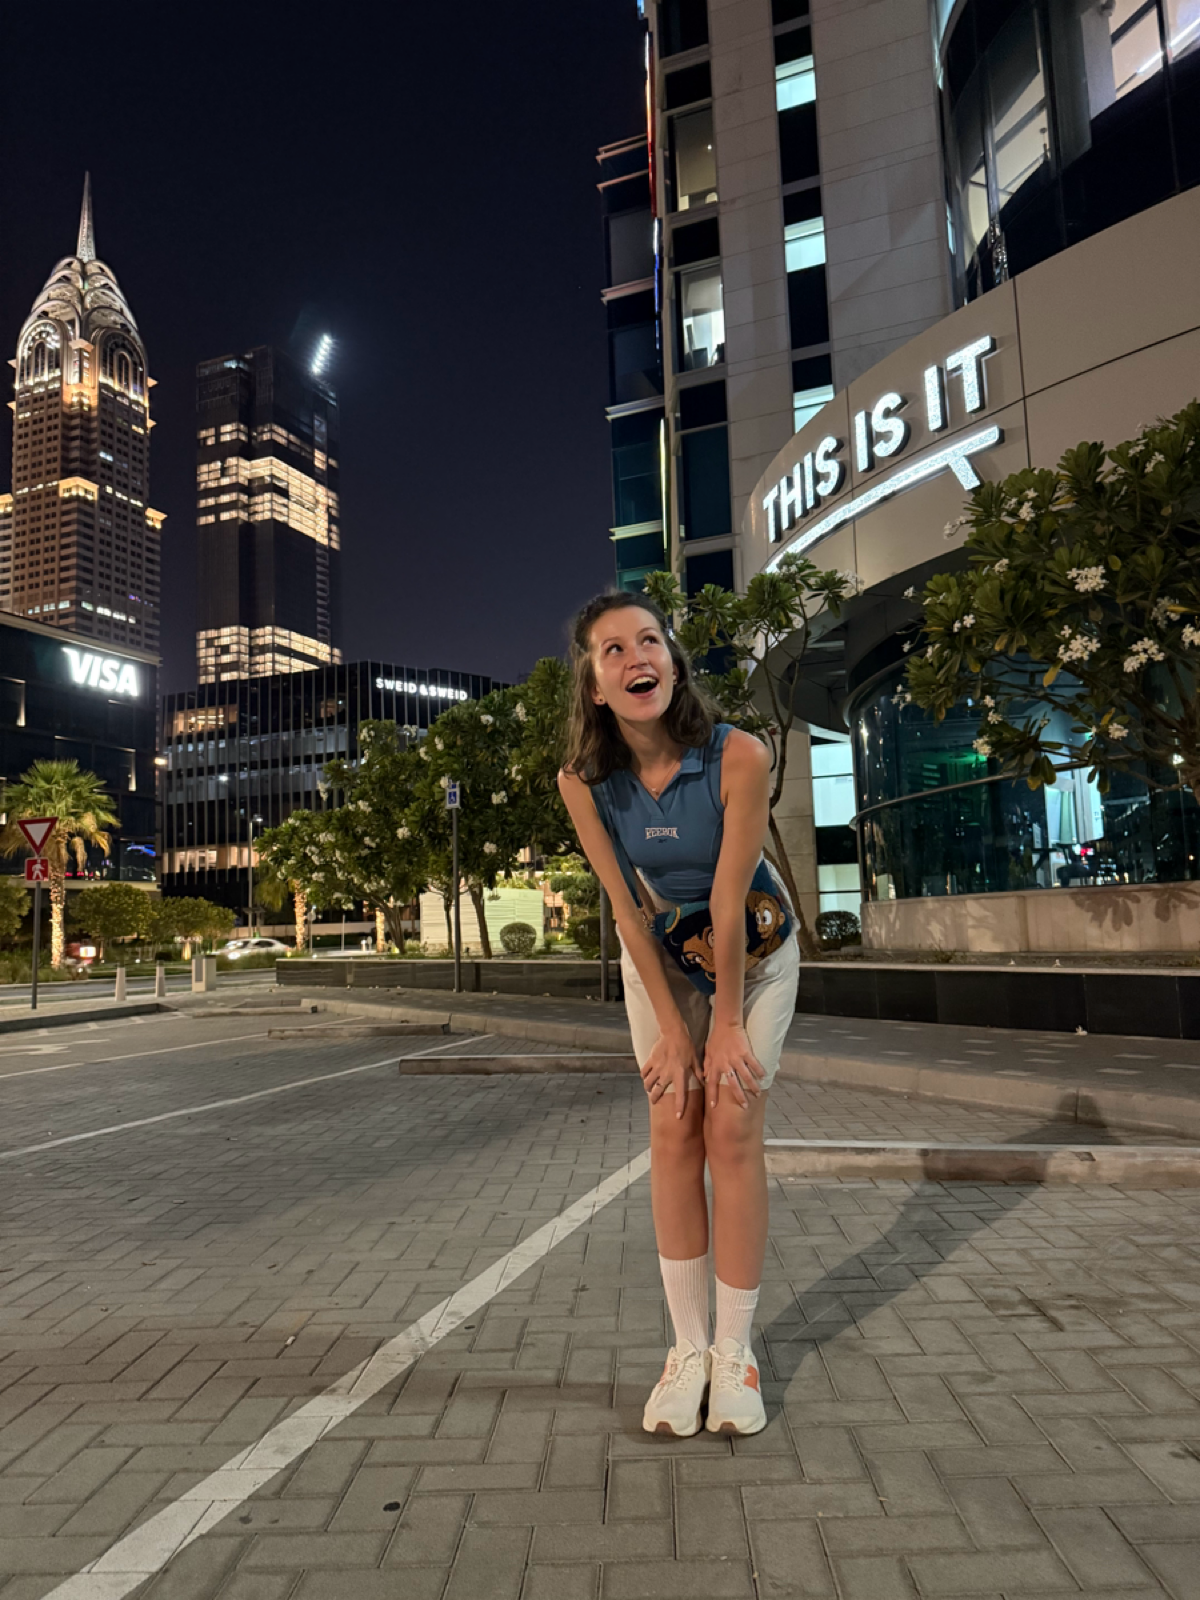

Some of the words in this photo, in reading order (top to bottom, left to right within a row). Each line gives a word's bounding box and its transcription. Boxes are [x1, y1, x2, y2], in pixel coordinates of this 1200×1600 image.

[763, 435, 842, 544] THIS
[854, 392, 907, 473] IS
[924, 335, 994, 432] IT
[61, 646, 139, 697] VISA
[375, 676, 418, 694] SWEID
[429, 684, 468, 701] SWEID
